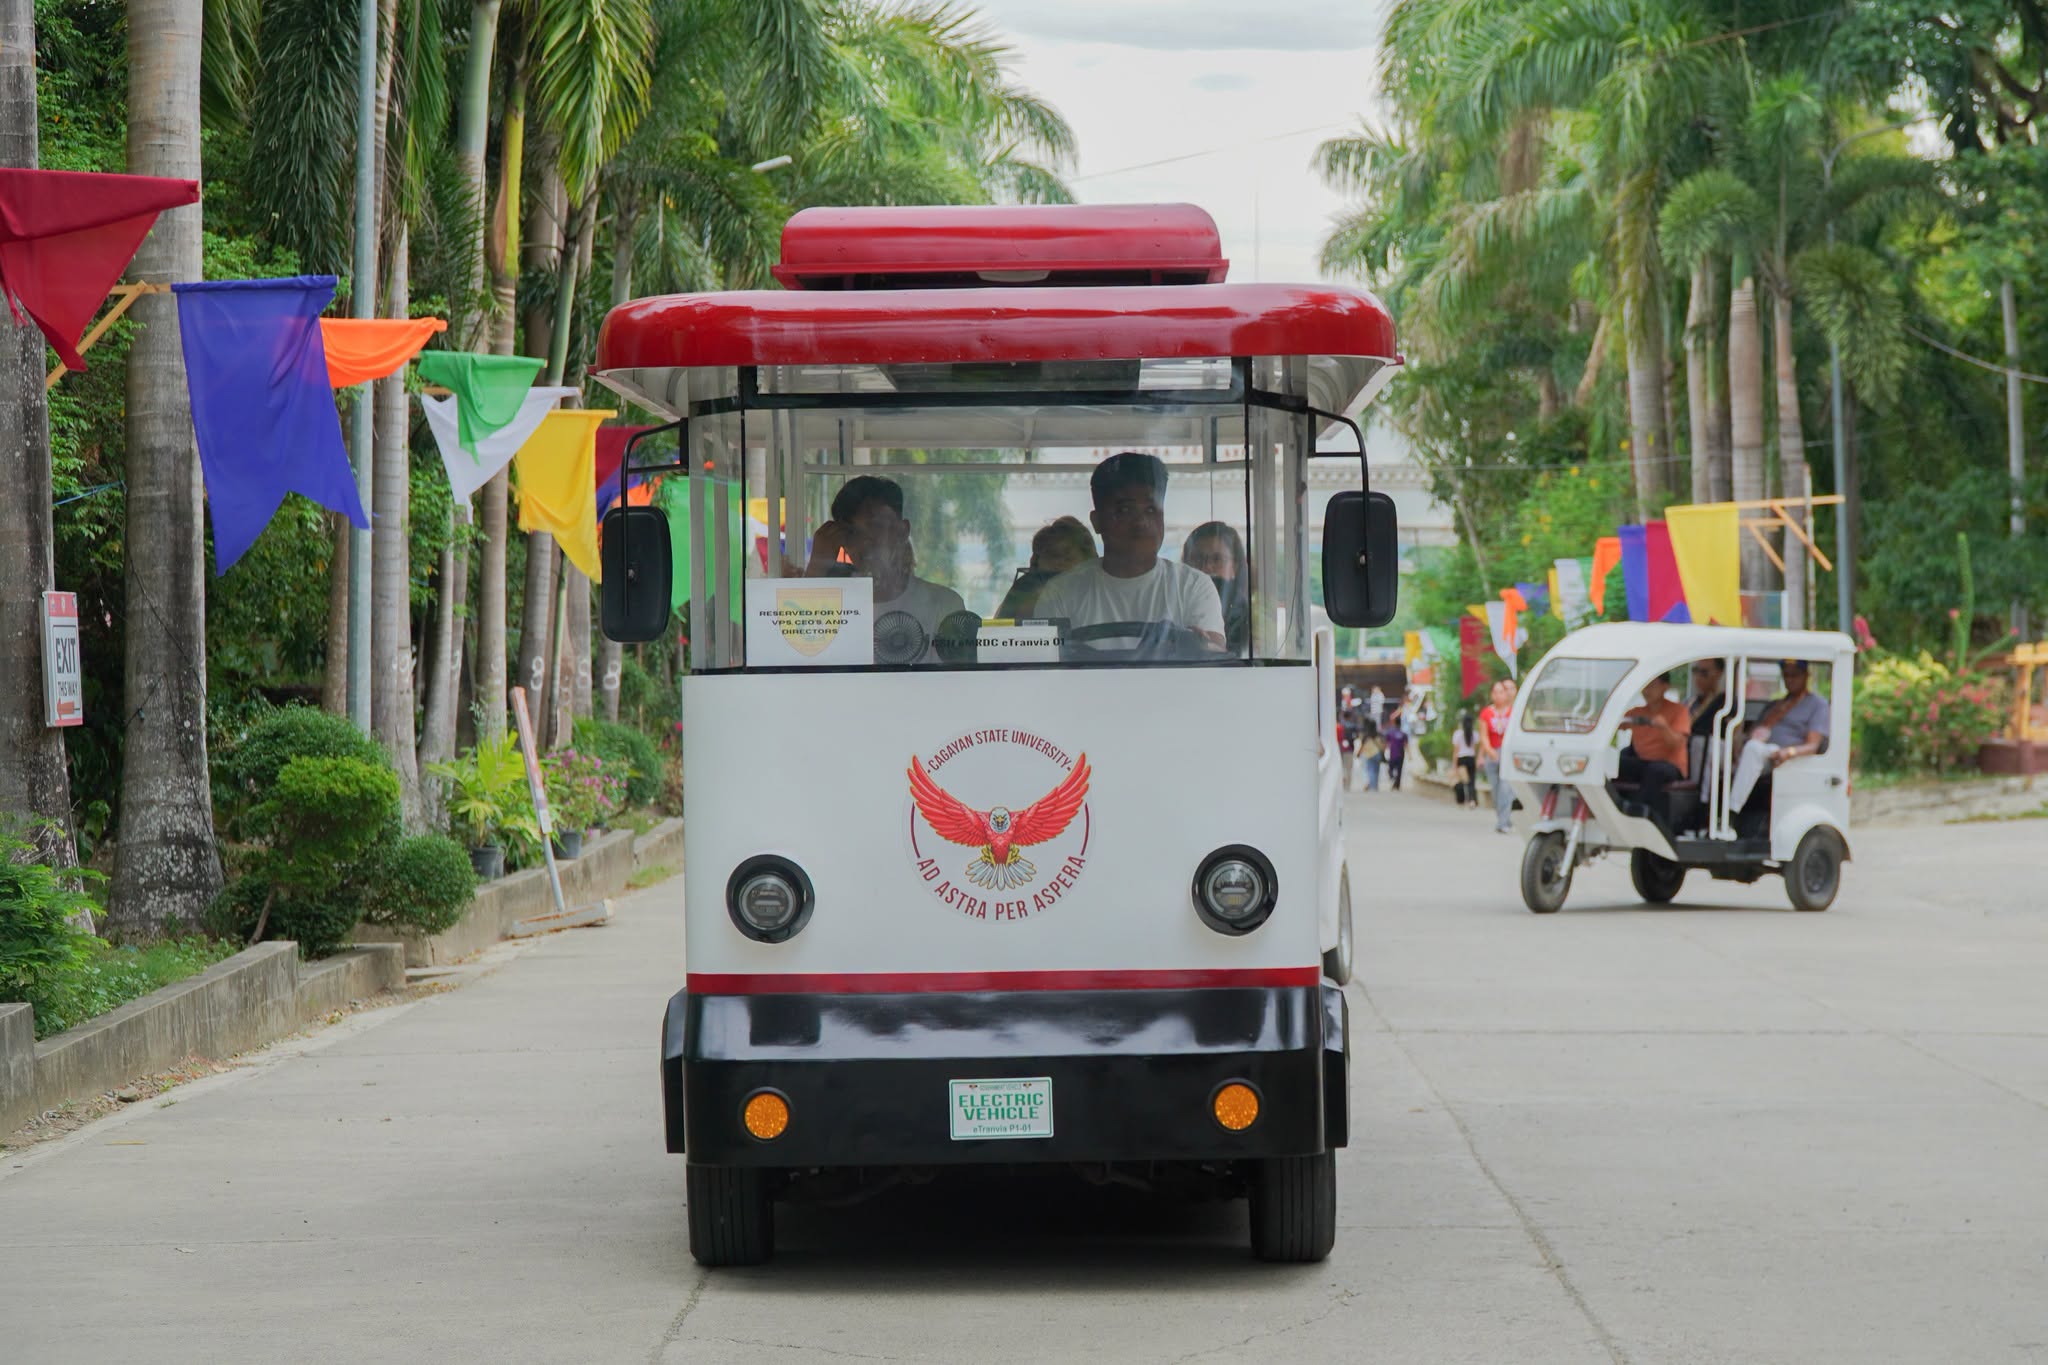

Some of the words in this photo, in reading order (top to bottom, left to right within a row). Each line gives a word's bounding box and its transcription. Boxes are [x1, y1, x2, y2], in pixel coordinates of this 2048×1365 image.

[1001, 637, 1050, 647] eTranvia
[56, 638, 76, 674] EXIT
[57, 681, 68, 697] THIS
[68, 681, 78, 696] WAY
[928, 734, 975, 771] CAGAYAN
[975, 729, 1009, 745] STATE
[1011, 730, 1072, 768] UNIVERSITY
[917, 858, 940, 881] AD
[934, 881, 987, 920] ASTRA
[995, 900, 1028, 921] PER
[1033, 855, 1086, 912] ASPERA
[958, 1092, 1044, 1107] ELECTRIC
[963, 1106, 1039, 1120] VEHICLE
[973, 1124, 1007, 1133] eTranvia
[1009, 1123, 1031, 1132] P1-01
